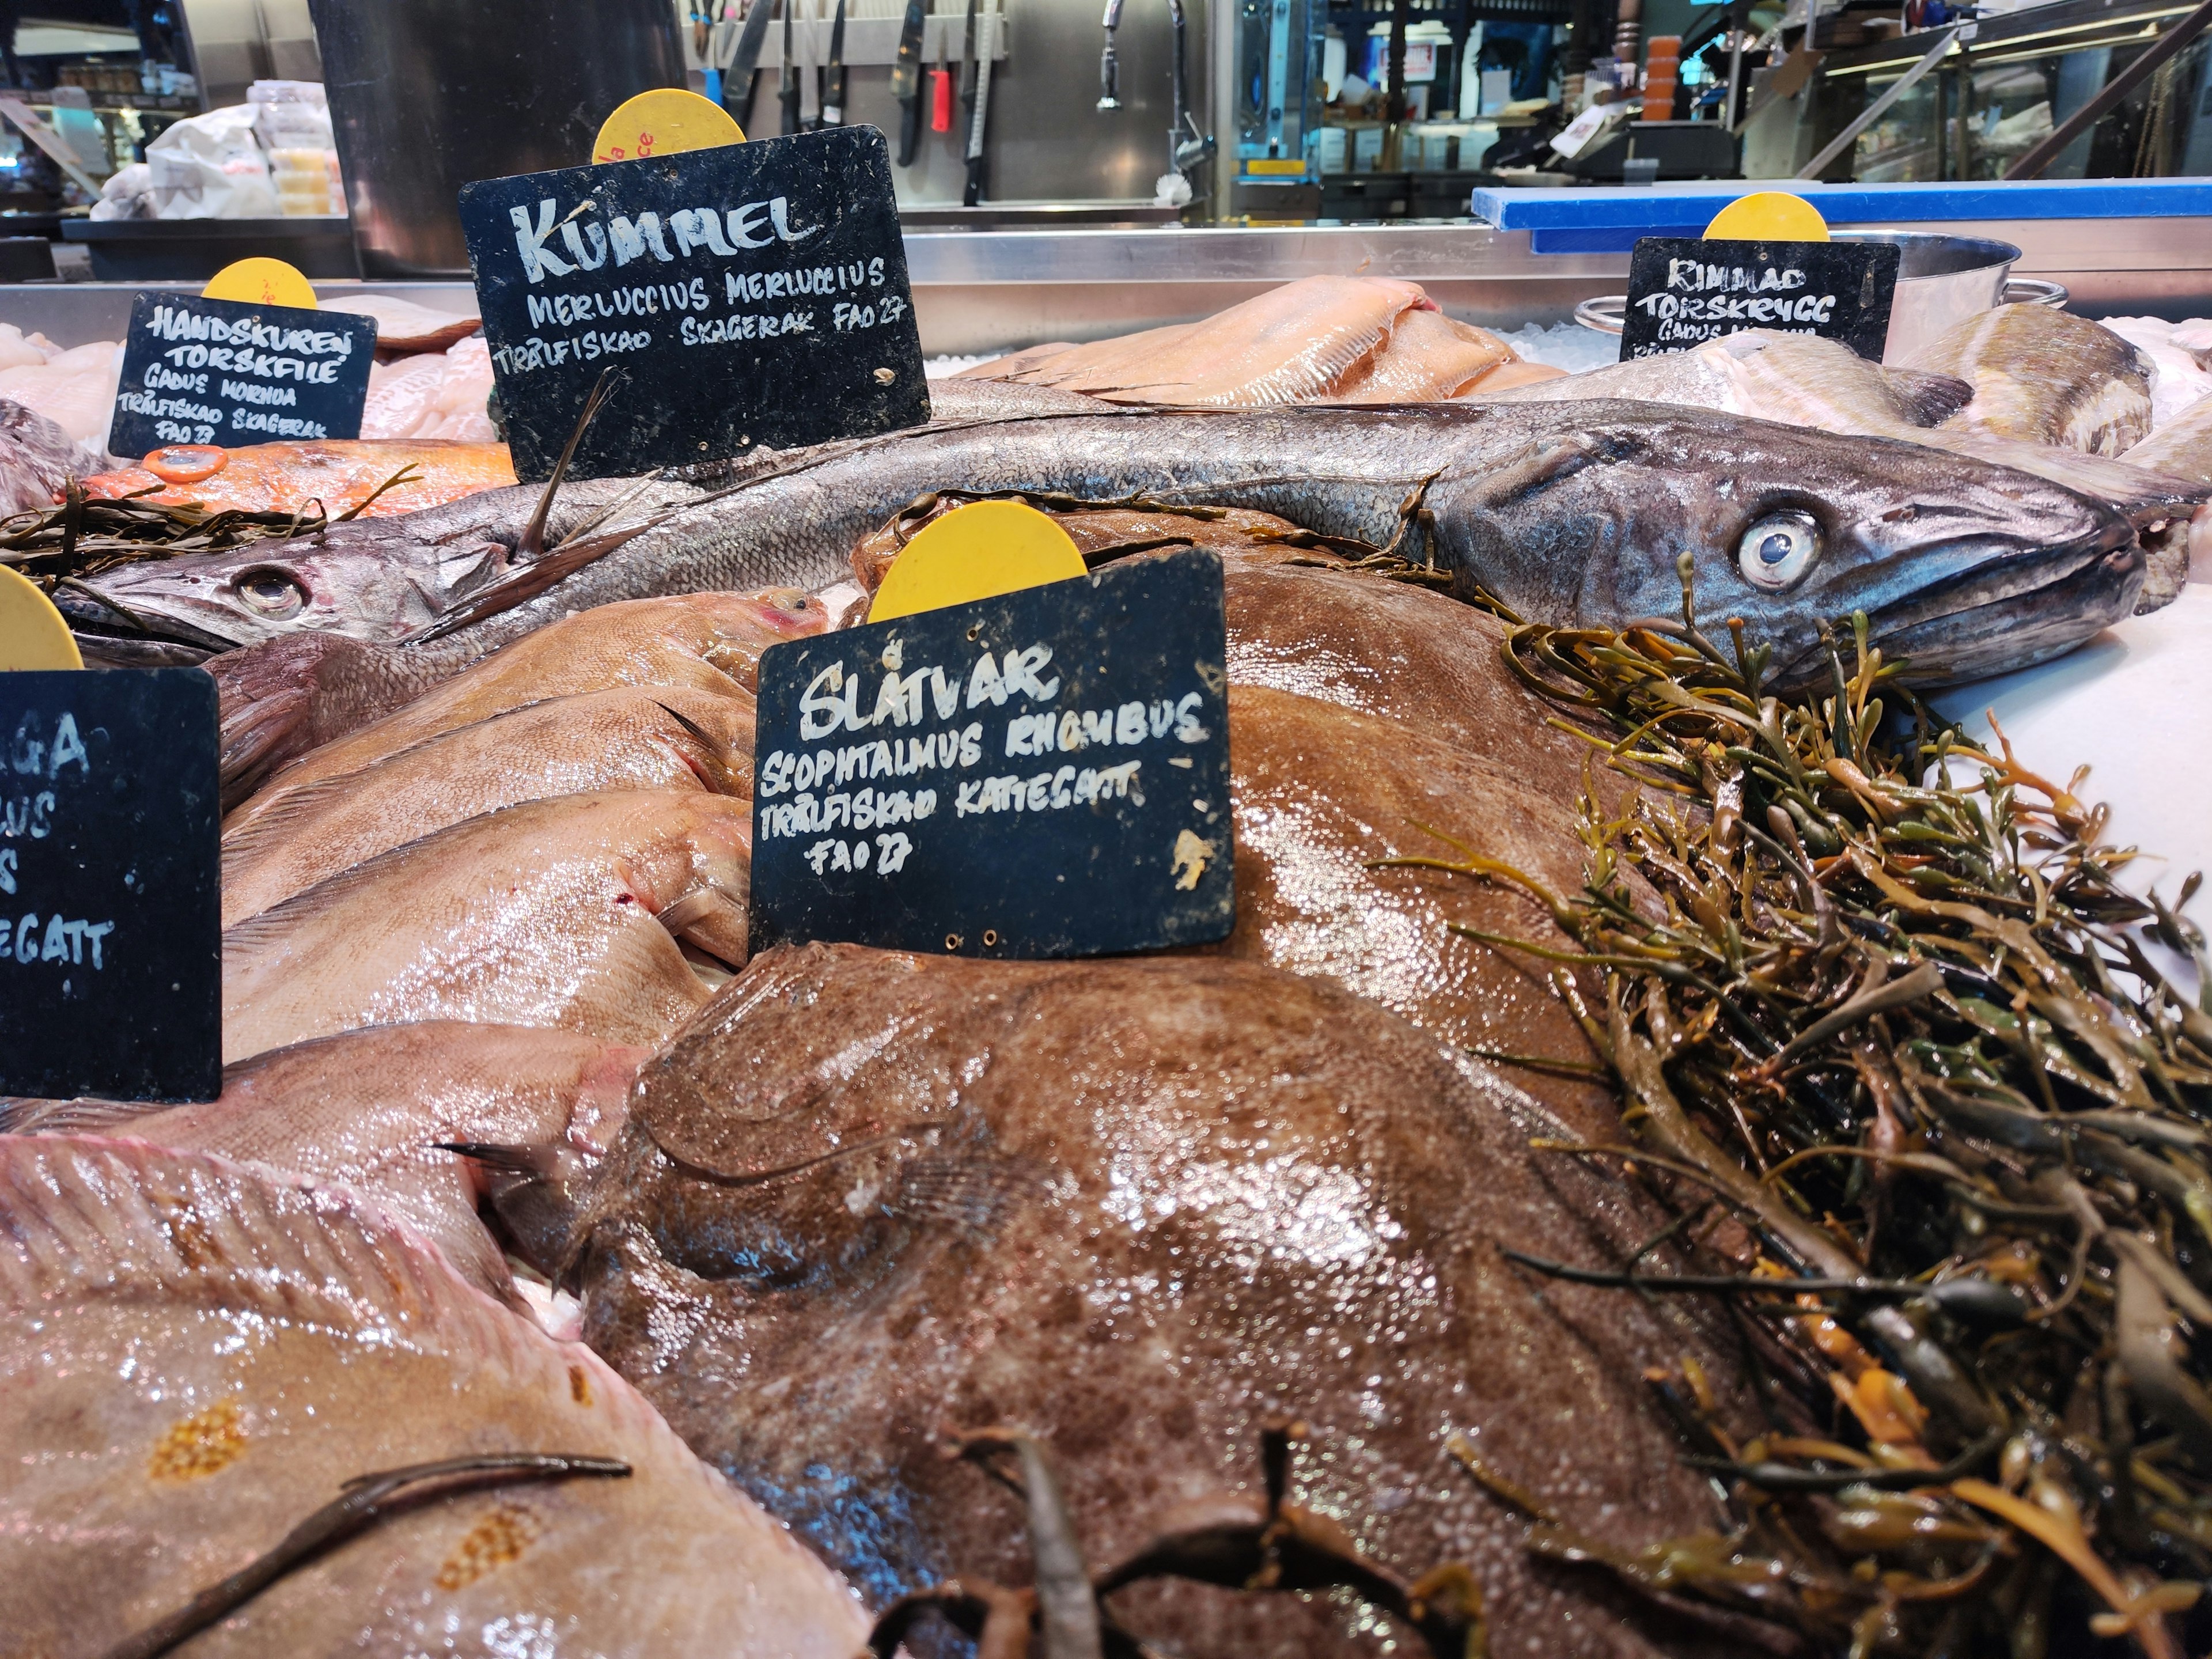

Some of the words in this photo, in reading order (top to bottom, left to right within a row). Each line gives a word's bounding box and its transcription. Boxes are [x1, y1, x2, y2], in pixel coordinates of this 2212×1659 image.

[509, 196, 816, 283] KUMMEL
[527, 278, 709, 328] MERLUCCIUS
[726, 257, 885, 305] MERLUCCIUS
[1668, 258, 1806, 293] RIMMAD
[680, 312, 815, 345] SKAGERAK
[832, 302, 875, 330] FAO
[880, 296, 907, 324] 27
[1635, 293, 1836, 323] TORSKRYGG
[145, 305, 353, 354] HANDSKUREN
[1658, 318, 1721, 341] GADUS
[144, 362, 209, 393] GADUS
[221, 379, 296, 406] MORHUA
[164, 344, 347, 384] TORSKFILÉ
[155, 420, 191, 443] FAO
[232, 408, 328, 438] SKAGERAK
[760, 722, 983, 797] SCOPHTALMUS
[1005, 692, 1209, 757] RHOMBUS
[955, 760, 1142, 818] KATTEGATT
[804, 839, 870, 876] FAO
